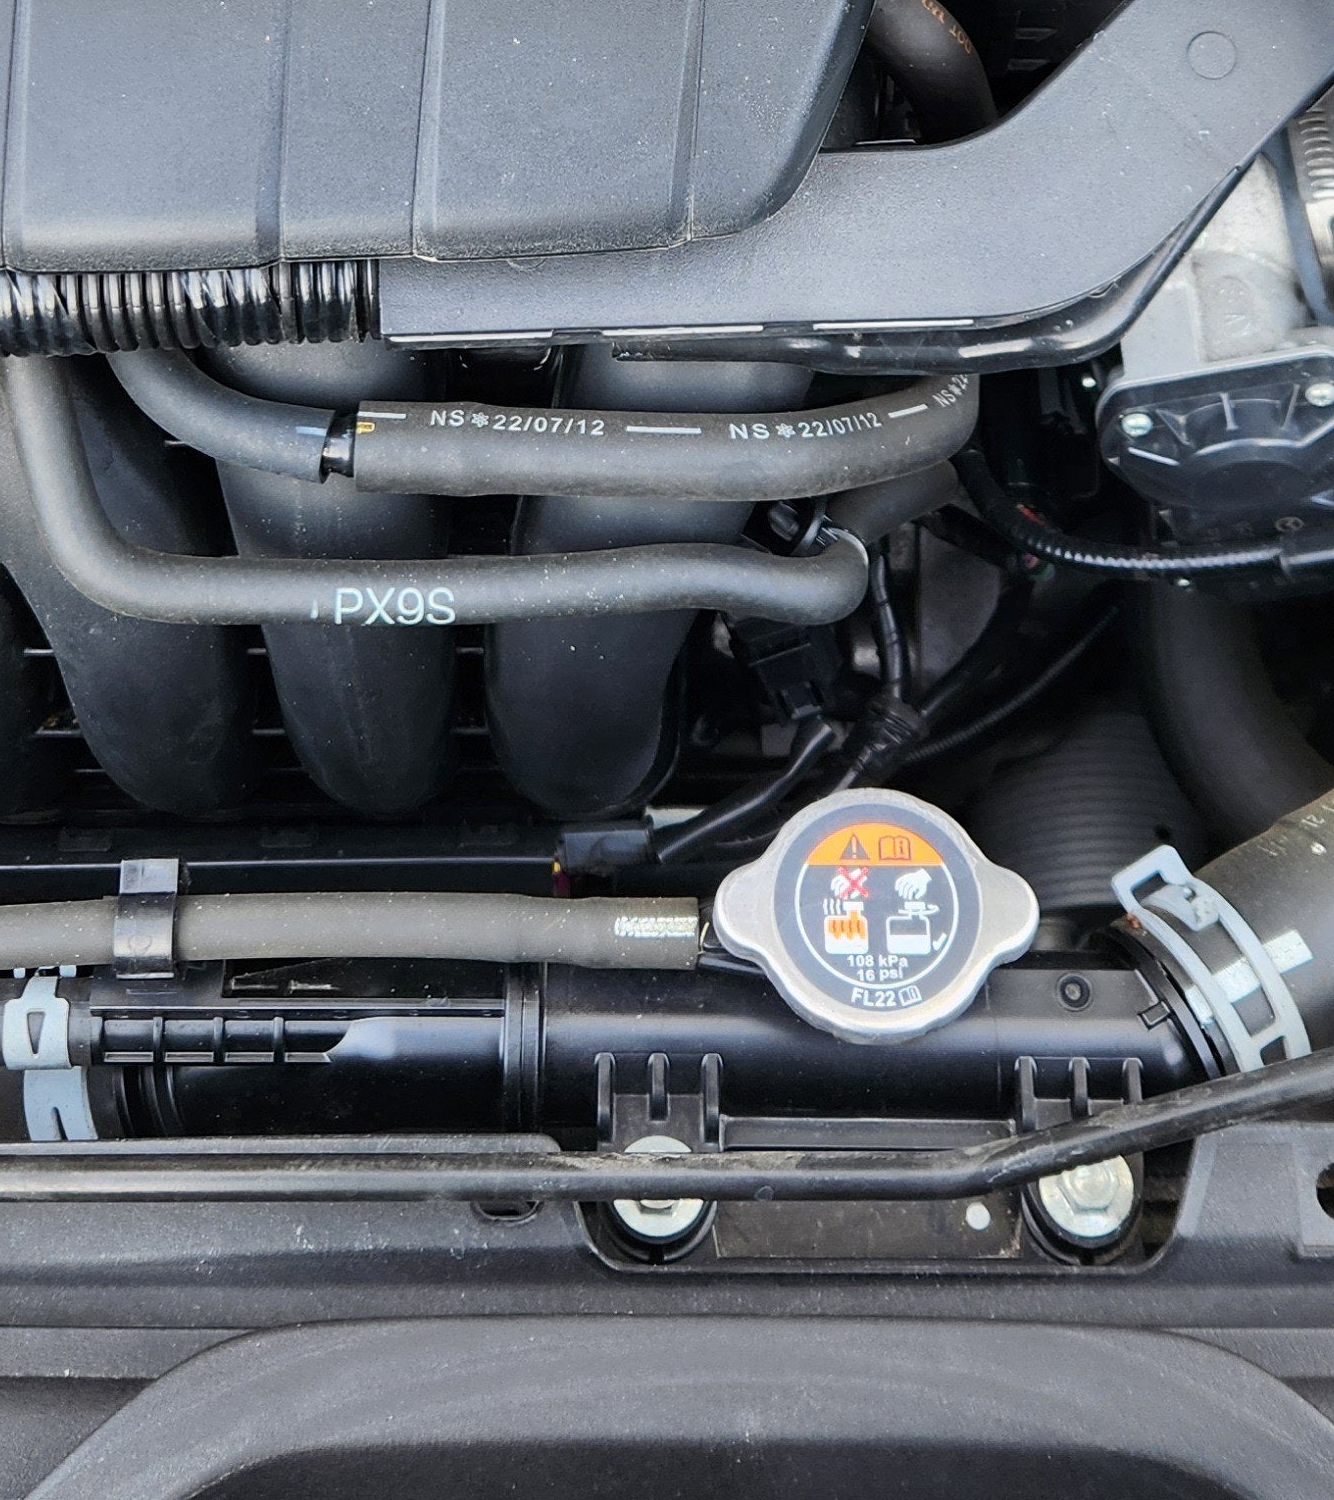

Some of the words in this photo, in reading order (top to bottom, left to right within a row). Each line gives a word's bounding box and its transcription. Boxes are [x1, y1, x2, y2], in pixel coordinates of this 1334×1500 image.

[334, 586, 456, 625] PX9S
[847, 954, 875, 967] 108
[878, 954, 909, 968] kPa
[857, 968, 875, 982] 16
[879, 966, 904, 982] psi
[851, 987, 897, 1007] FL22
